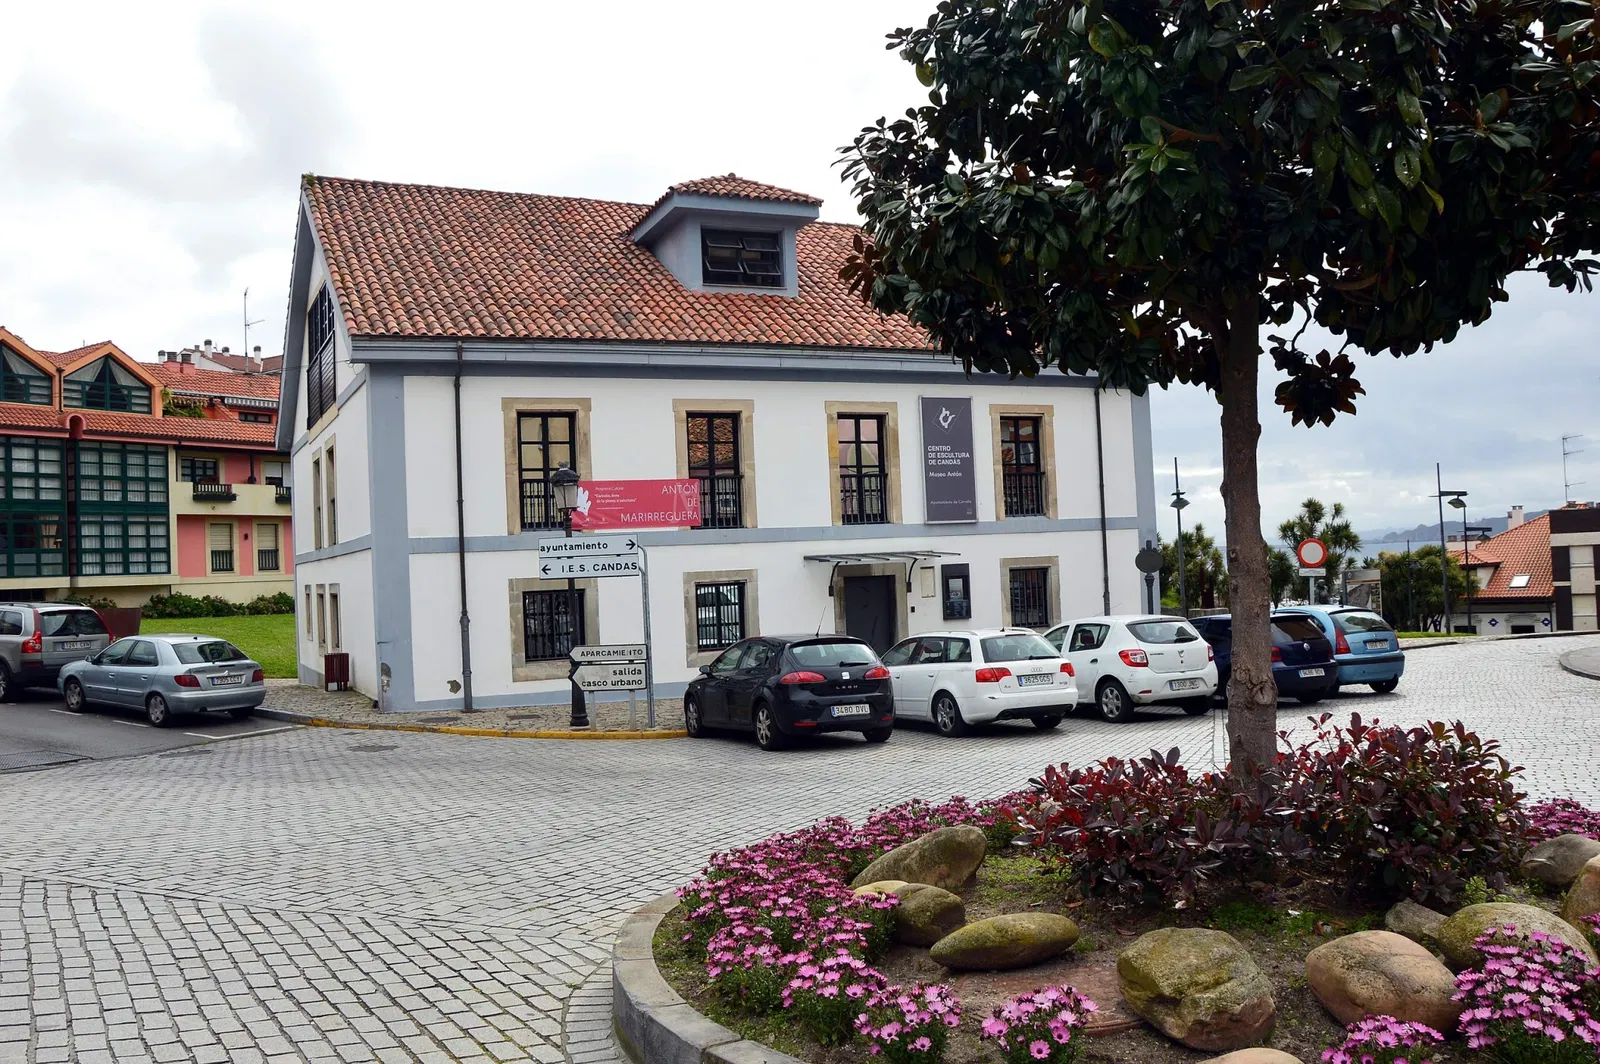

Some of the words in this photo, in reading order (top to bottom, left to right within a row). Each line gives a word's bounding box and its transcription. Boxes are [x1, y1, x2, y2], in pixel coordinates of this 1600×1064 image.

[661, 482, 698, 495] ANTÓN
[687, 497, 698, 507] DE
[620, 511, 699, 523] MARIRREGUERA
[540, 542, 608, 553] ayuntamiento
[561, 564, 590, 573] I.E.S.
[592, 561, 638, 572] CANDAS
[613, 667, 642, 676] salida
[611, 678, 643, 687] urbano
[1023, 675, 1040, 684] 3625
[835, 706, 853, 715] 3480
[855, 705, 869, 713] DVL
